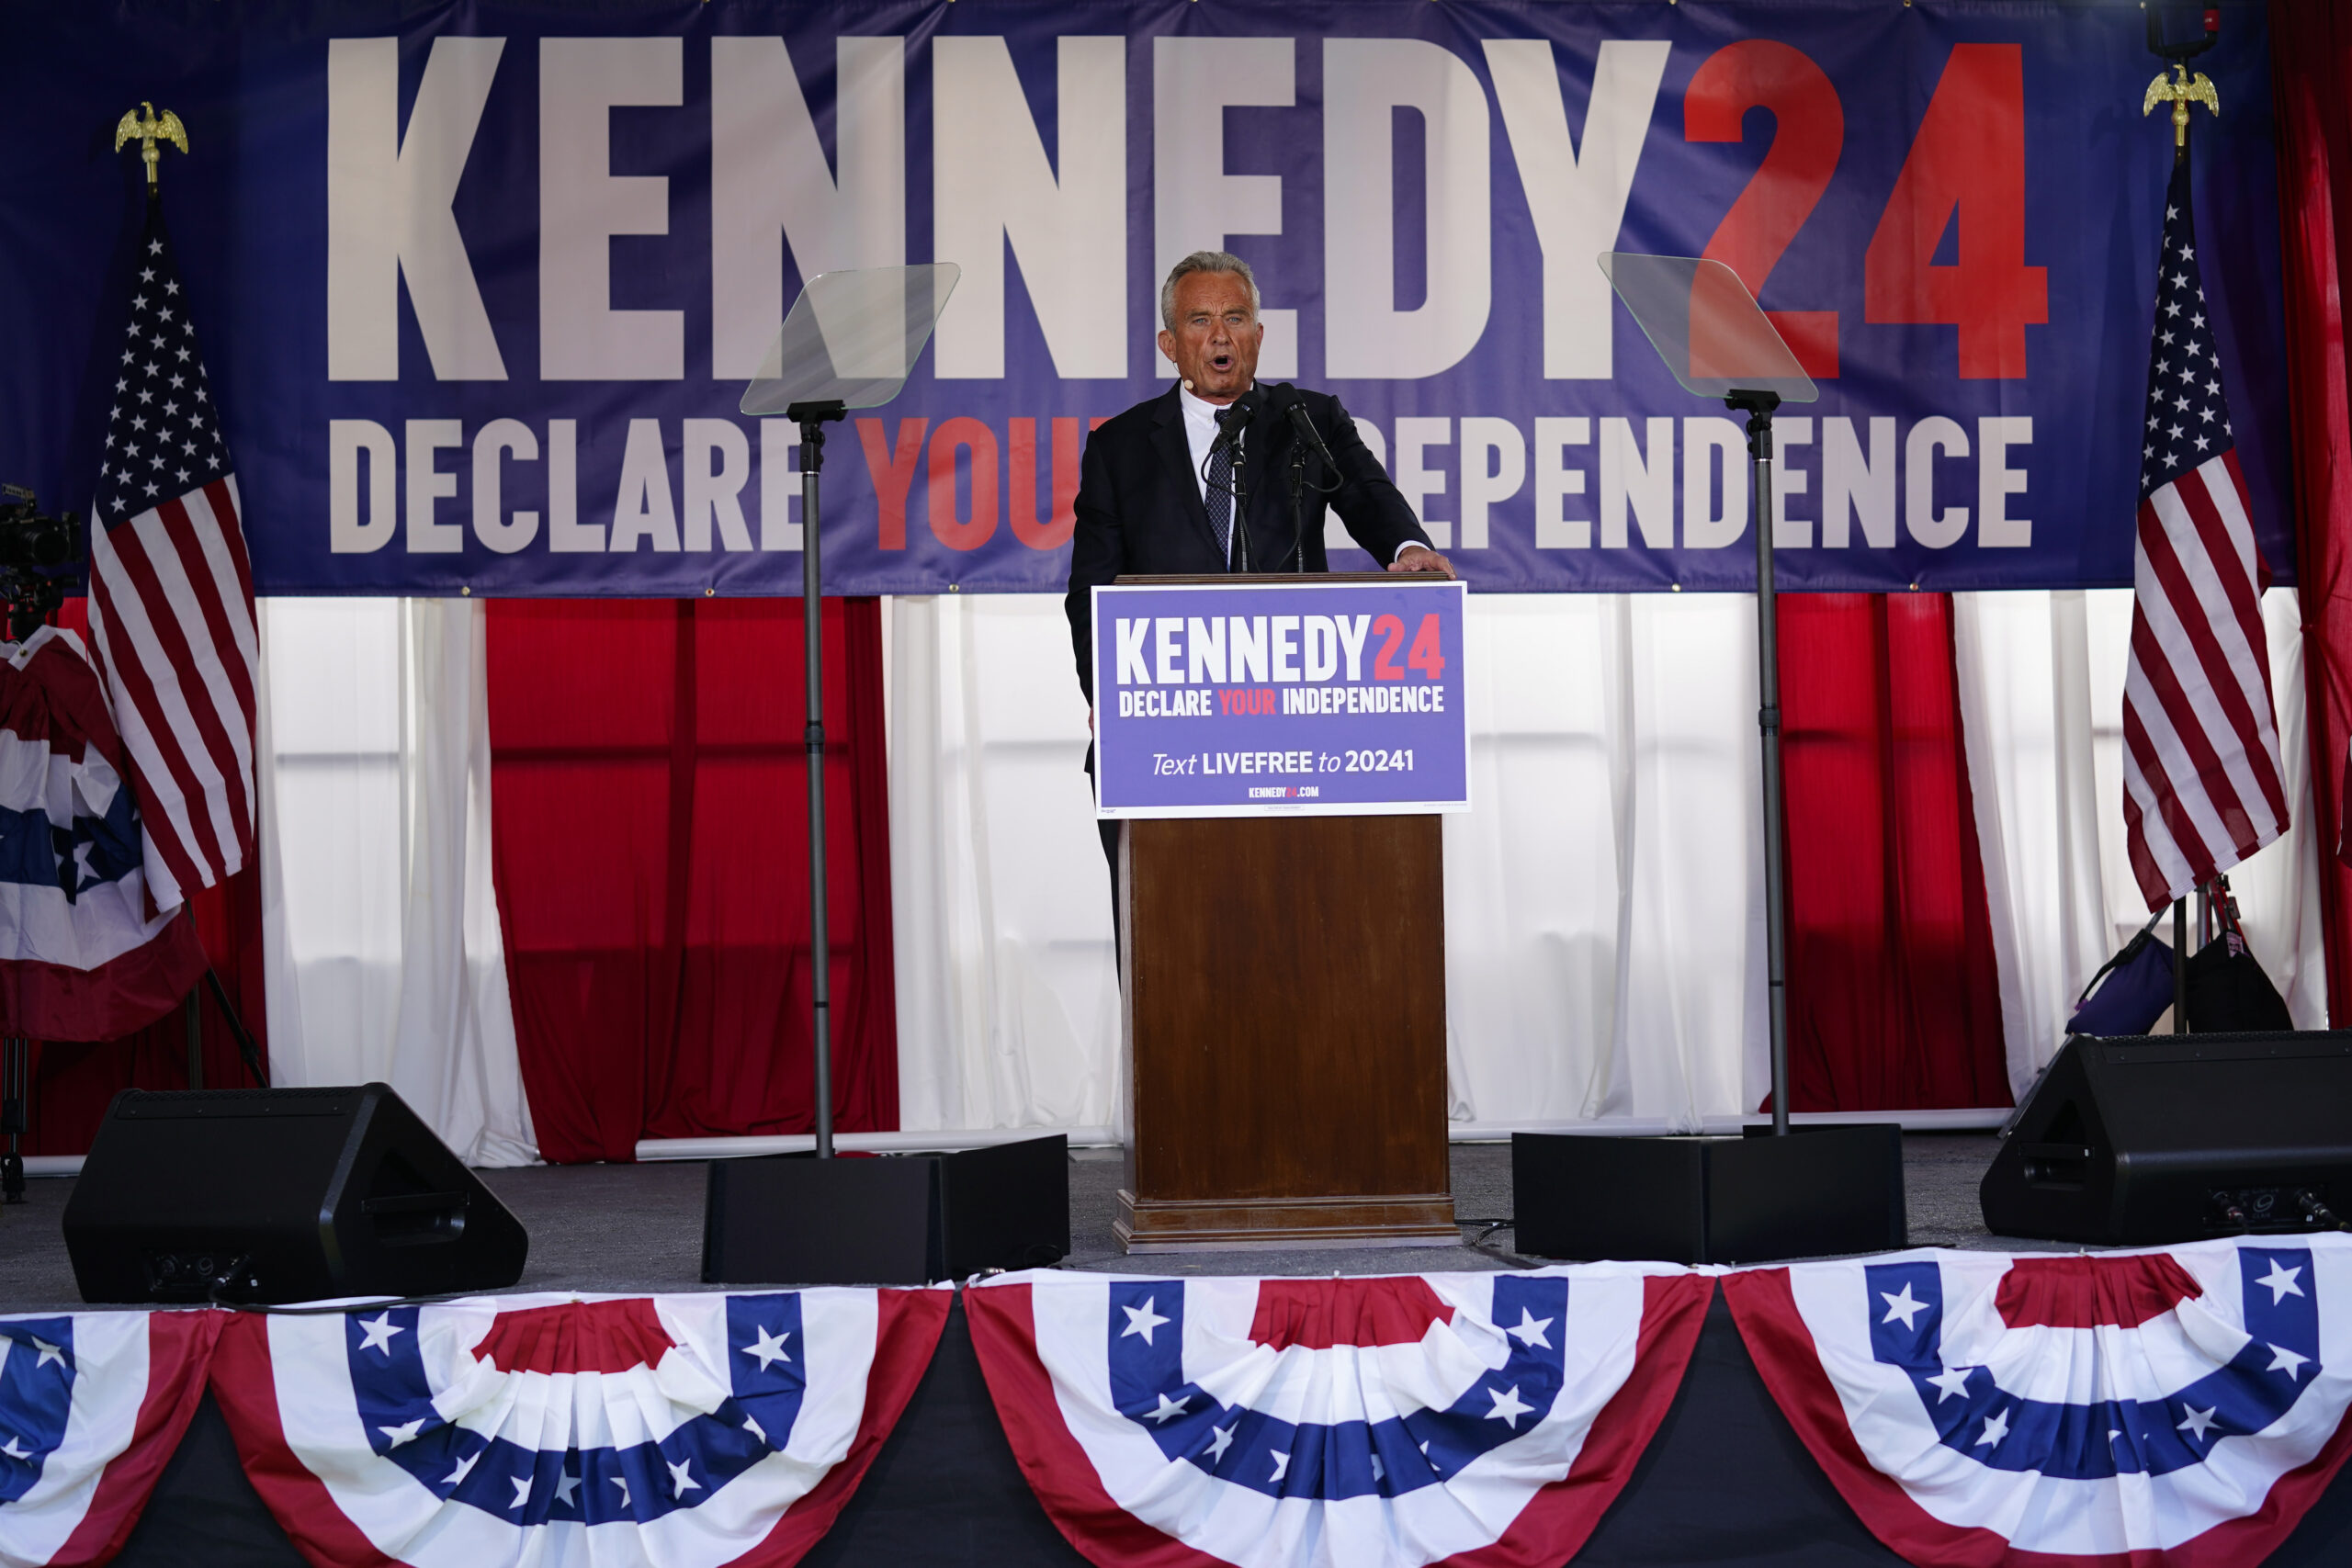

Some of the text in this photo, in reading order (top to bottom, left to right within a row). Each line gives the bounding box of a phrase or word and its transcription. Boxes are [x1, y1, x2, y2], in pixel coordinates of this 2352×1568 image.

[329, 415, 2033, 554] DECLARE YOU EPENDENCE
[1119, 685, 1444, 717] DECLARE YOUR INDEPENDENCE
[1152, 750, 1414, 775] Text LIVEFREE to 20241
[1249, 785, 1319, 798] KENNEDY24.COM
